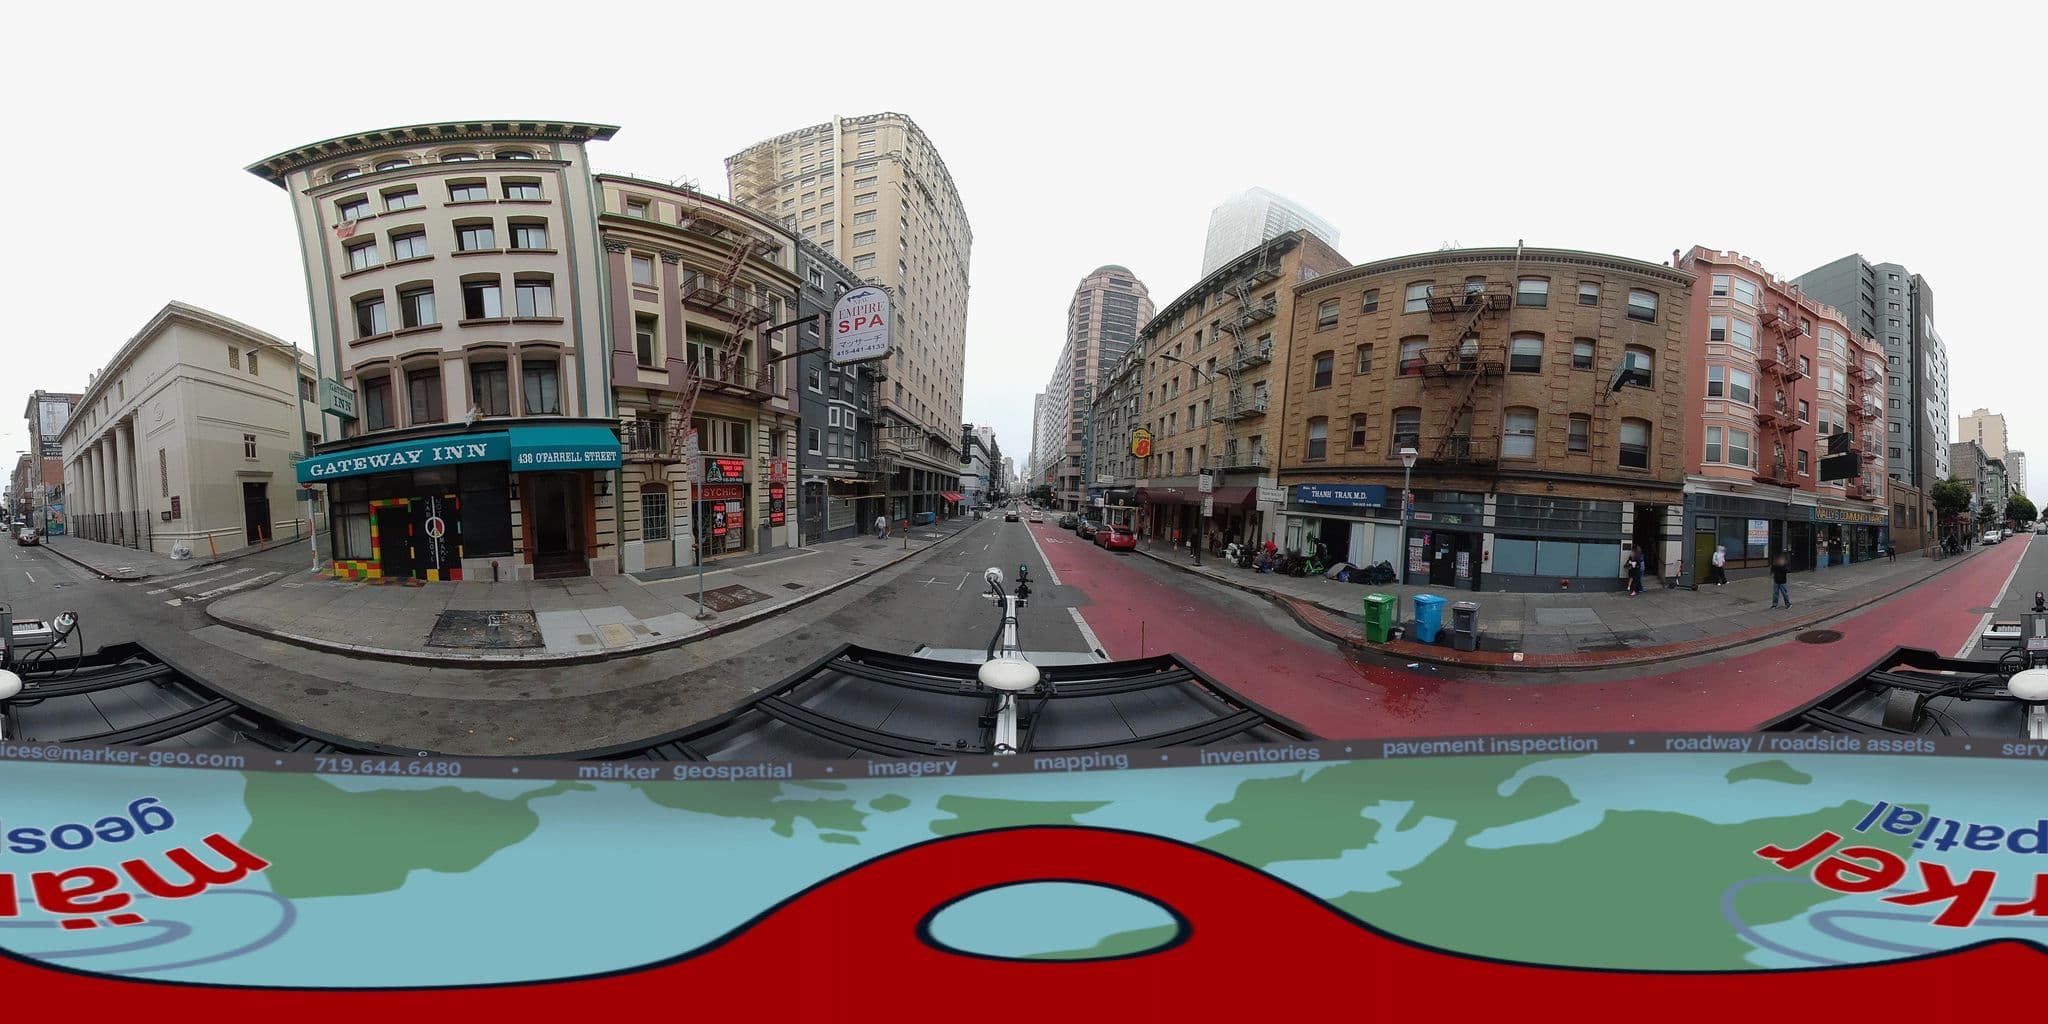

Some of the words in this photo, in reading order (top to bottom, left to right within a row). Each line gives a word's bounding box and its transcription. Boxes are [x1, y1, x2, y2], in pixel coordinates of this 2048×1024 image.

[838, 301, 886, 319] EMPIRE
[838, 314, 884, 333] SPA
[836, 343, 885, 356] 415-441-4133
[329, 383, 353, 400] GATEWAY
[334, 396, 352, 412] INN
[310, 450, 424, 477] GATEWAY
[432, 443, 488, 461] INN
[517, 454, 533, 464] 438
[536, 452, 582, 463] O'FARRELL
[585, 451, 617, 462] STREET
[704, 488, 737, 497] SYCHIC
[1335, 491, 1352, 499] TRAN
[1353, 492, 1367, 500] M.D.
